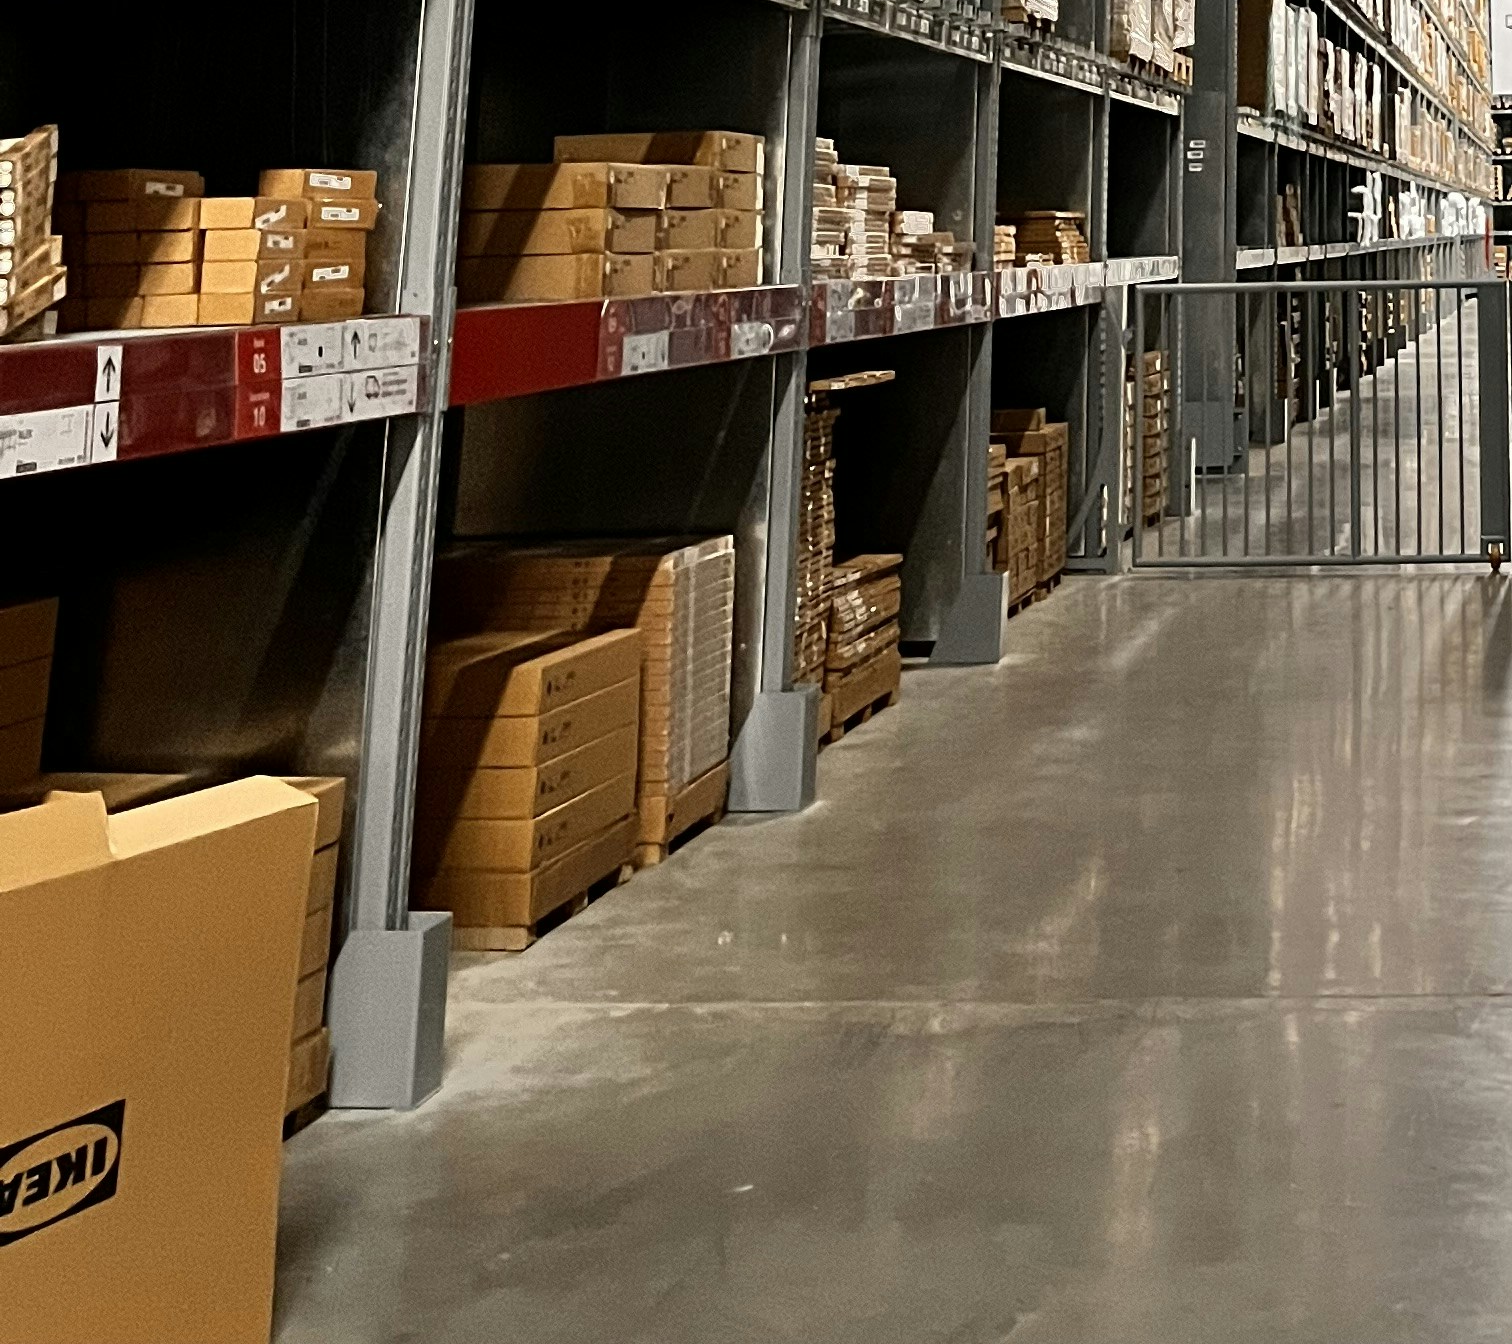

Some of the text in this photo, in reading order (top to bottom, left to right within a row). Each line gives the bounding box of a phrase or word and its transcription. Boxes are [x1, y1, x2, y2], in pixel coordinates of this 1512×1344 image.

[252, 353, 267, 374] 05
[253, 405, 267, 427] 10
[0, 1135, 109, 1219] IKEA
